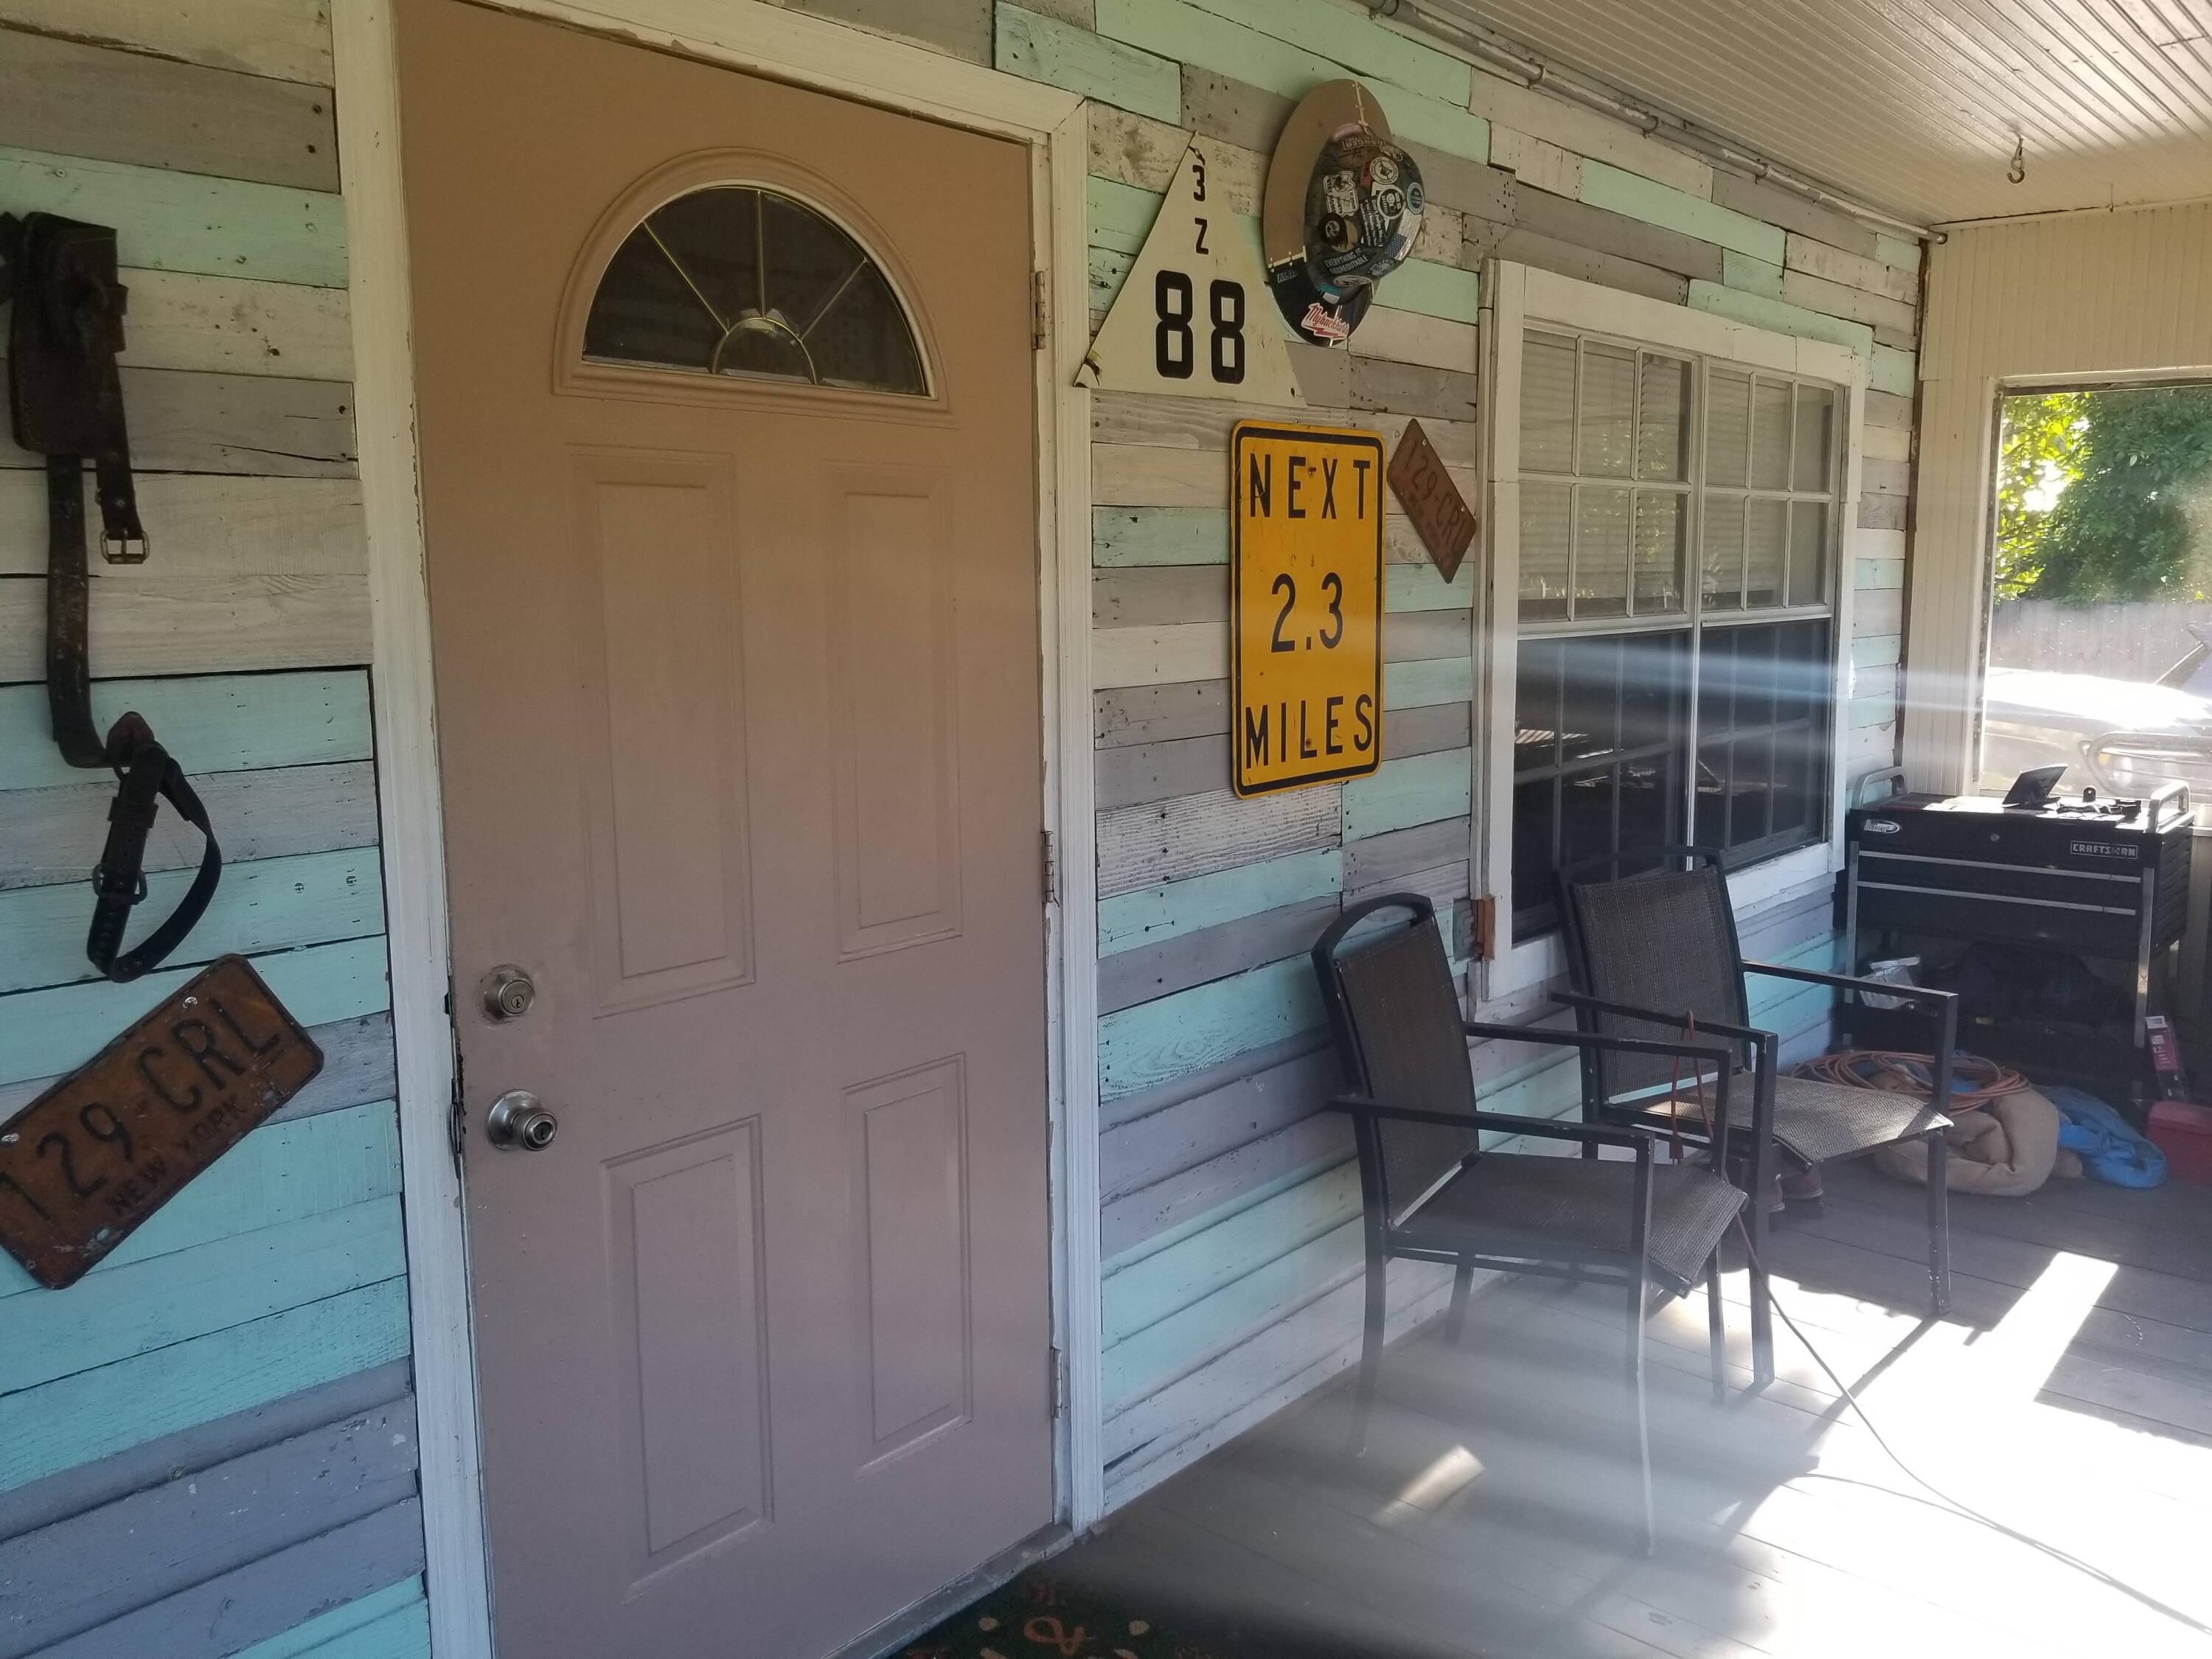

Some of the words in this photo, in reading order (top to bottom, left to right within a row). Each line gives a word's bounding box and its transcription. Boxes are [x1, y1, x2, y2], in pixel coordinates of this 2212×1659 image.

[1192, 164, 1206, 202] 3
[1155, 270, 1245, 384] 88
[1250, 453, 1371, 519] NEXT
[1271, 571, 1343, 653] 2.3
[1245, 694, 1373, 769] MILES
[2072, 844, 2136, 857] CRAFTSMAN
[138, 997, 281, 1113] CRL
[173, 1094, 247, 1152] YORK
